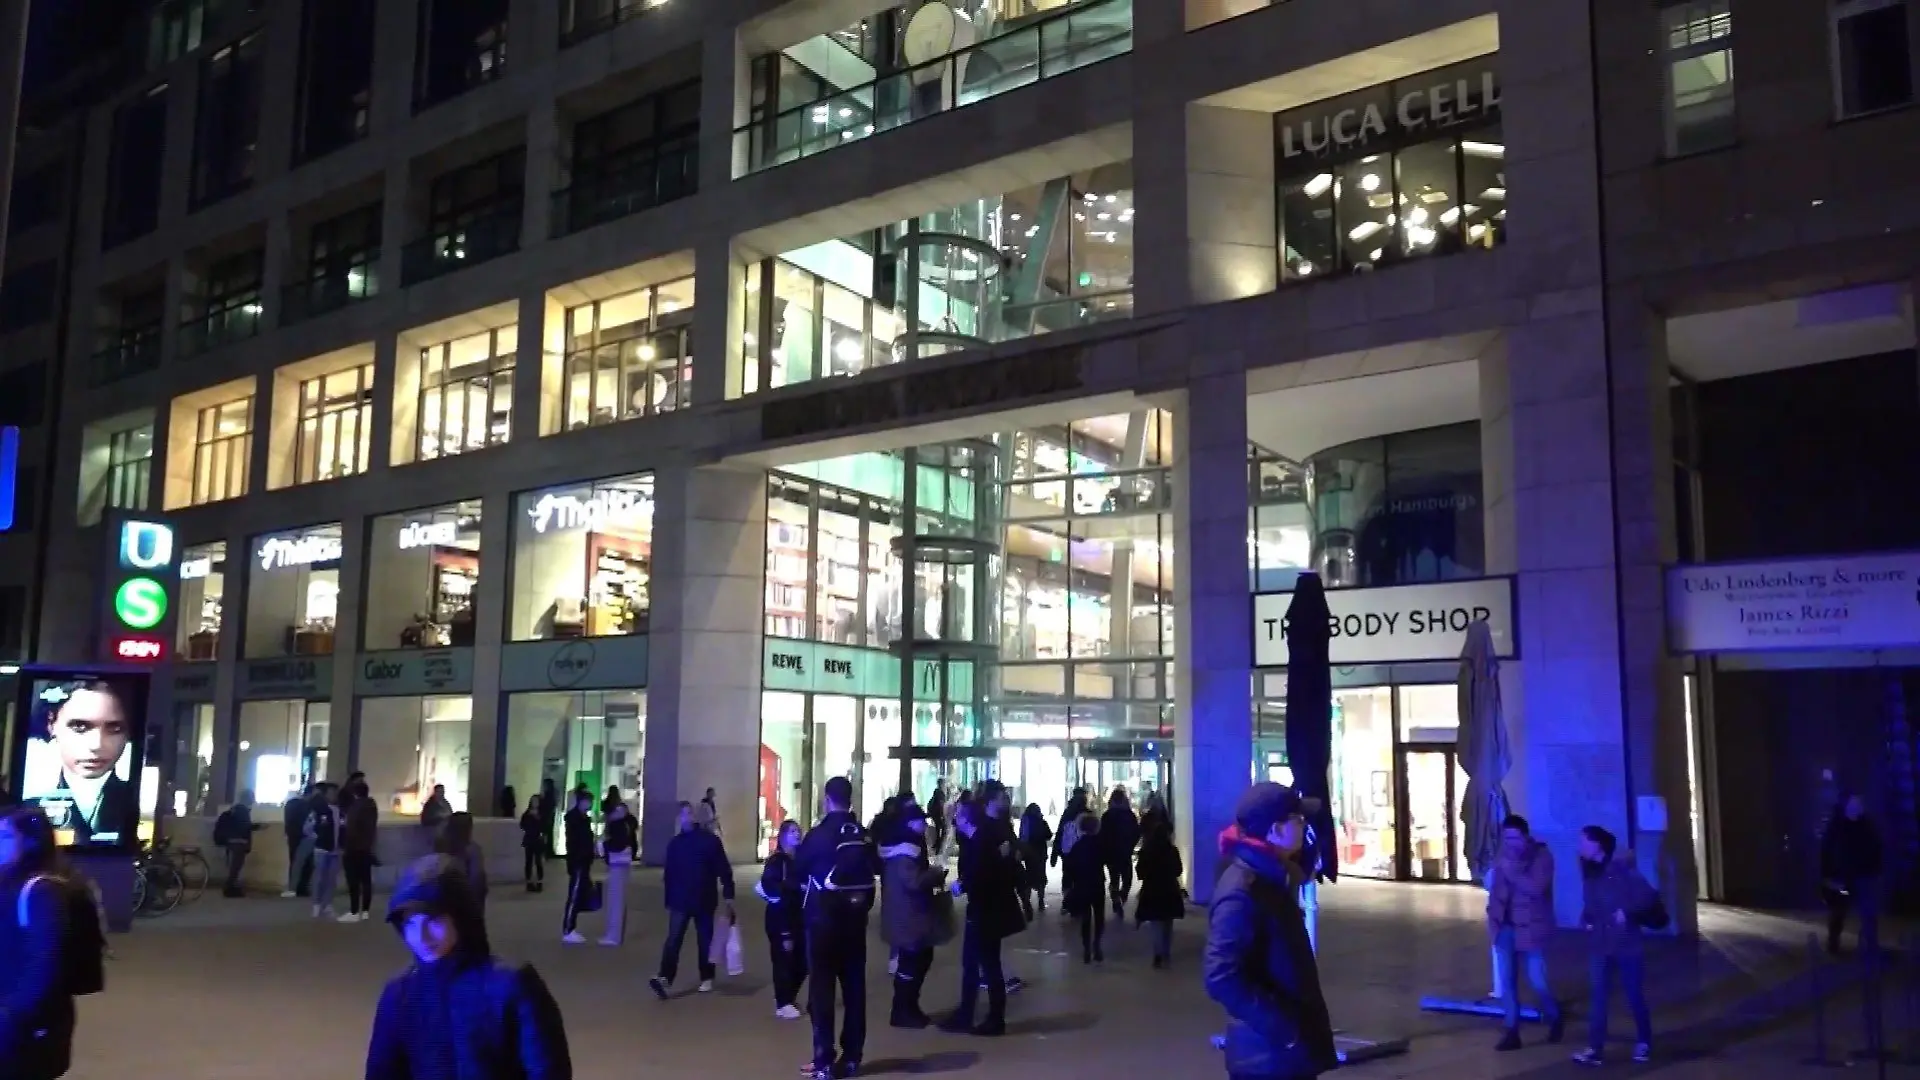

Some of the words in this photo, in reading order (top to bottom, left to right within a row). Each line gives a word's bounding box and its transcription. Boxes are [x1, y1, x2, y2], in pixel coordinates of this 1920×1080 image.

[1283, 103, 1387, 158] LUCA
[125, 521, 173, 569] U
[1684, 577, 1721, 594] Udo
[1727, 571, 1828, 592] Lindenberg
[1833, 567, 1850, 584] &
[1858, 570, 1907, 584] more
[124, 579, 159, 629] S
[1740, 607, 1793, 623] James
[1801, 603, 1849, 621] Rizzi
[1329, 612, 1400, 638] BODY
[364, 659, 403, 680] Gabor
[772, 654, 803, 670] REWE
[824, 659, 852, 674] REWE
